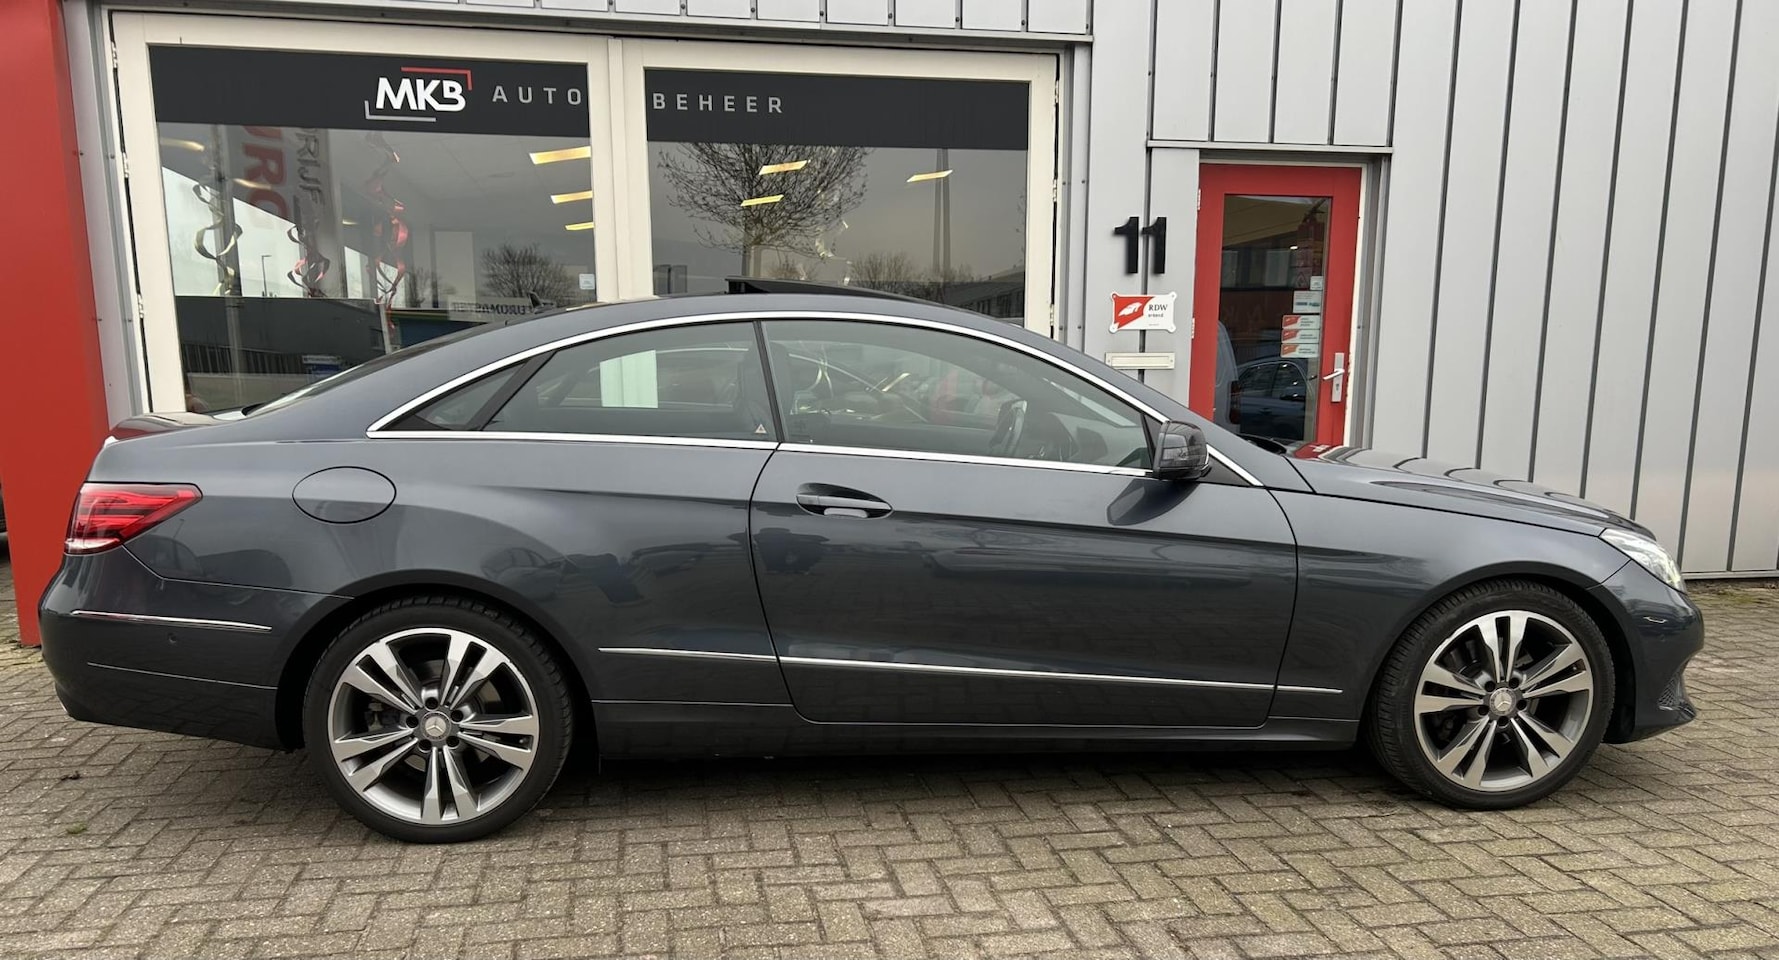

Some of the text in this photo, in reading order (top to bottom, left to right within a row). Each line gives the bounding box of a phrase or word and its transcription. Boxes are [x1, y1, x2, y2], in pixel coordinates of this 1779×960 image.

[375, 77, 782, 114] MKB AUTO BEHEER
[1114, 216, 1167, 275] 11
